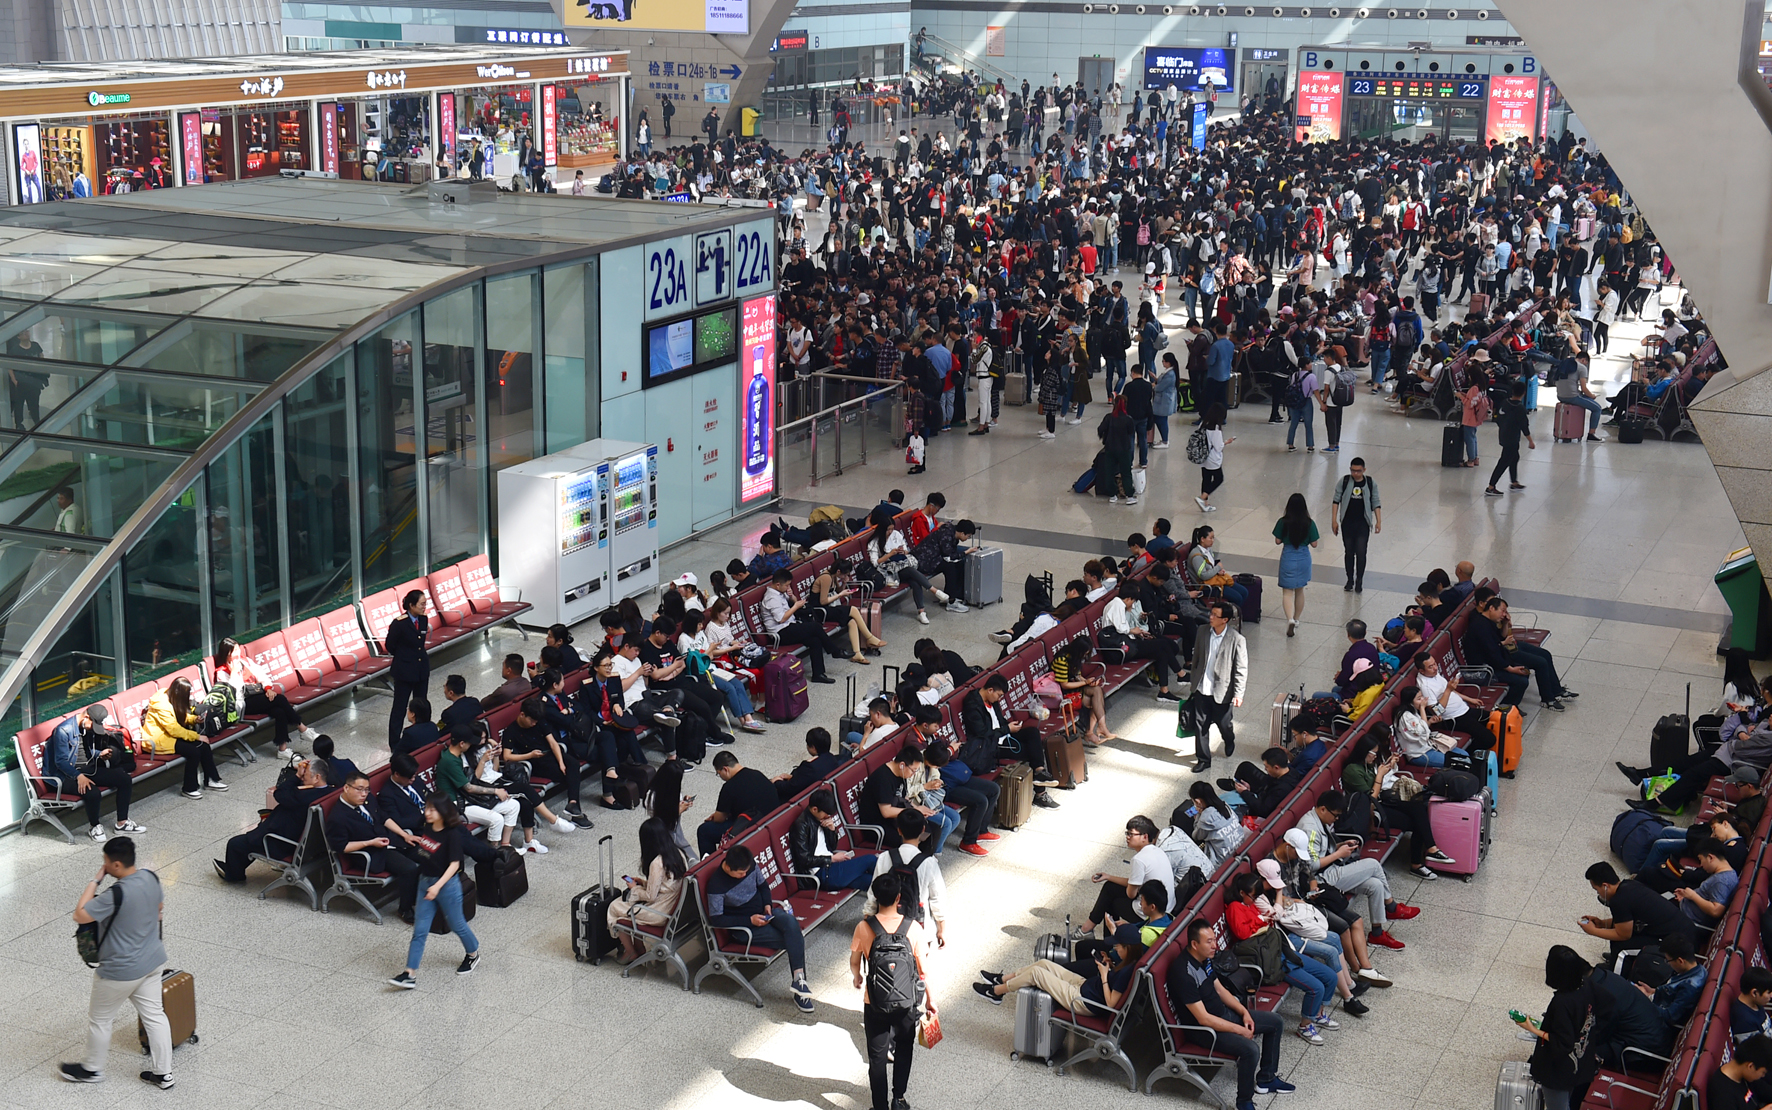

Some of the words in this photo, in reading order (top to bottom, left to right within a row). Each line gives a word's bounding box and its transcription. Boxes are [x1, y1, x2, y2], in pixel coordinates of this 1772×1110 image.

[815, 36, 820, 48] B
[1306, 52, 1317, 67] B
[1522, 57, 1535, 73] B
[1300, 82, 1340, 94] 财富传媒
[1354, 81, 1370, 93] 23
[1462, 84, 1479, 96] 22
[1492, 88, 1535, 99] 财富传媒
[545, 88, 553, 144] 手机配件
[737, 231, 770, 288] 22A
[650, 248, 687, 310] 23A
[292, 630, 322, 650] 天下名品
[255, 644, 287, 664] 天下名品
[1029, 655, 1048, 675] 天下名品
[1007, 671, 1026, 691] 天下名品
